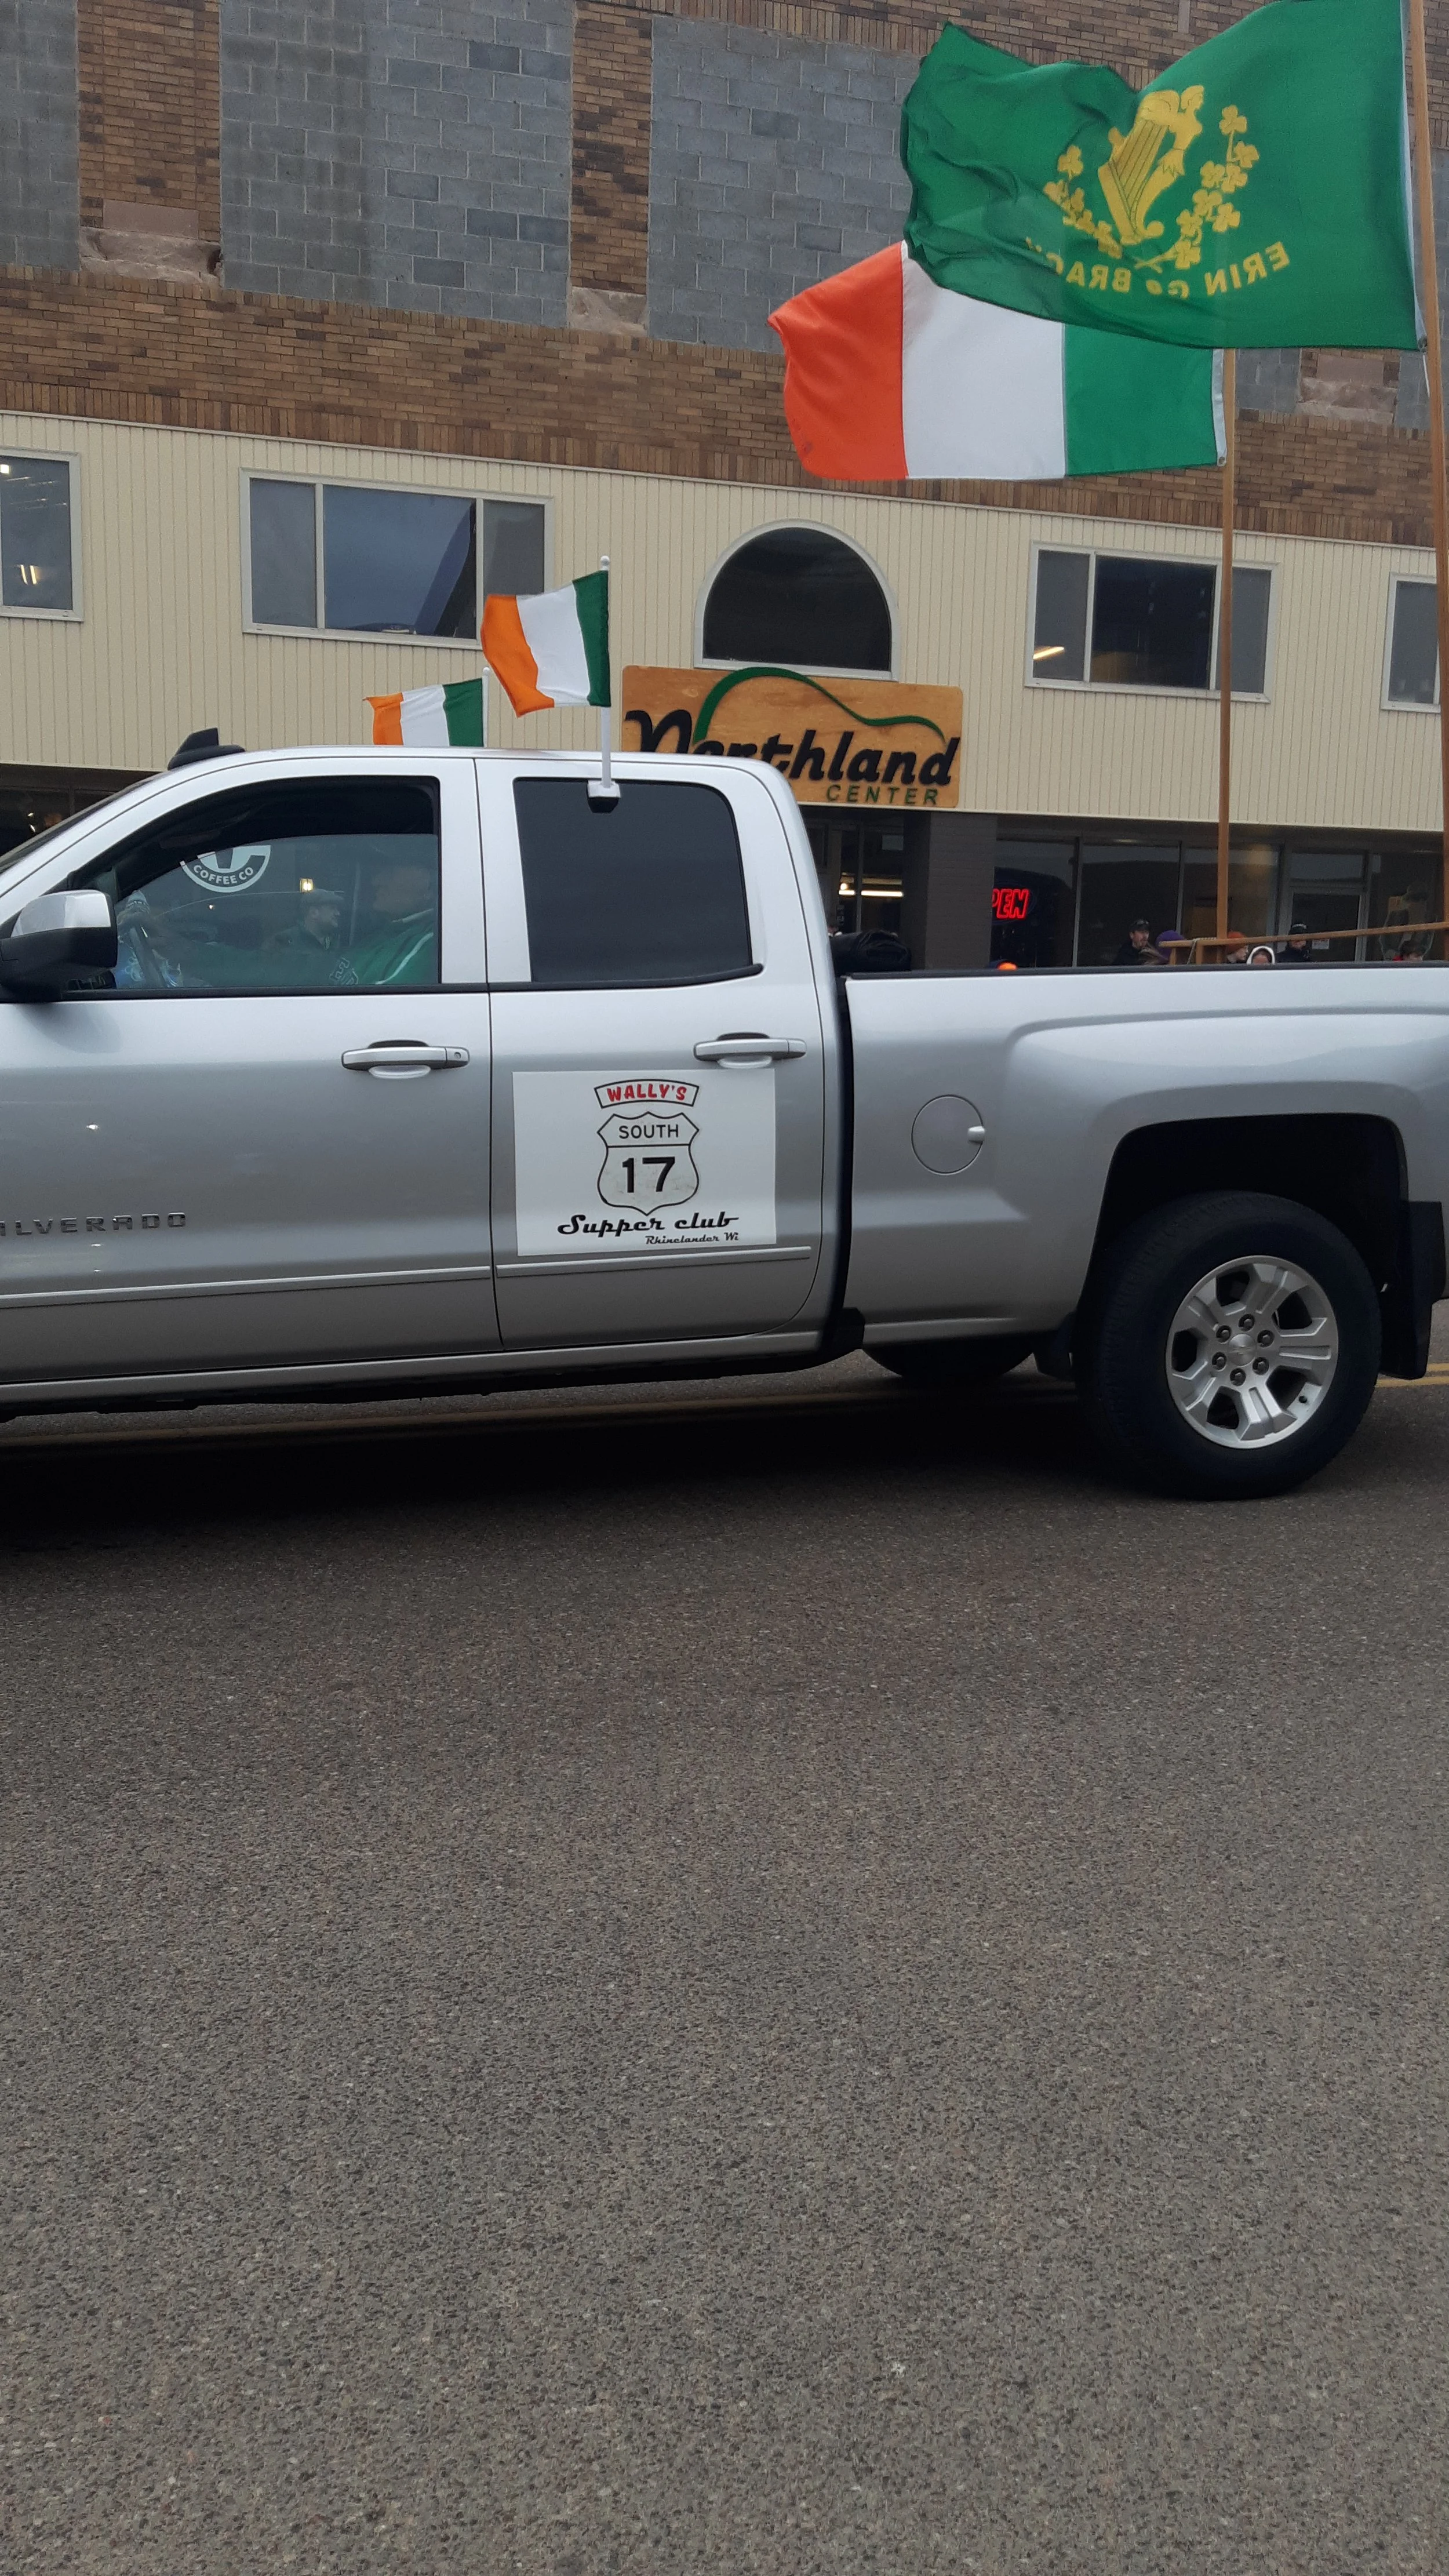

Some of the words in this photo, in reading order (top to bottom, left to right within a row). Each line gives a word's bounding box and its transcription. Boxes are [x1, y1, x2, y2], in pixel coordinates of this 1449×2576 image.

[827, 784, 938, 805] CENTER
[194, 865, 238, 885] COFFEE
[239, 867, 254, 880] CO
[992, 888, 1030, 919] PEN
[606, 1083, 687, 1102] WALLY'S
[618, 1124, 679, 1139] SOUTH
[622, 1156, 676, 1193] 17
[0, 1212, 186, 1236] ILVERADO
[557, 1214, 665, 1238] Supper
[674, 1211, 739, 1229] club
[645, 1235, 719, 1245] Rhinelander
[724, 1232, 739, 1241] Wi
